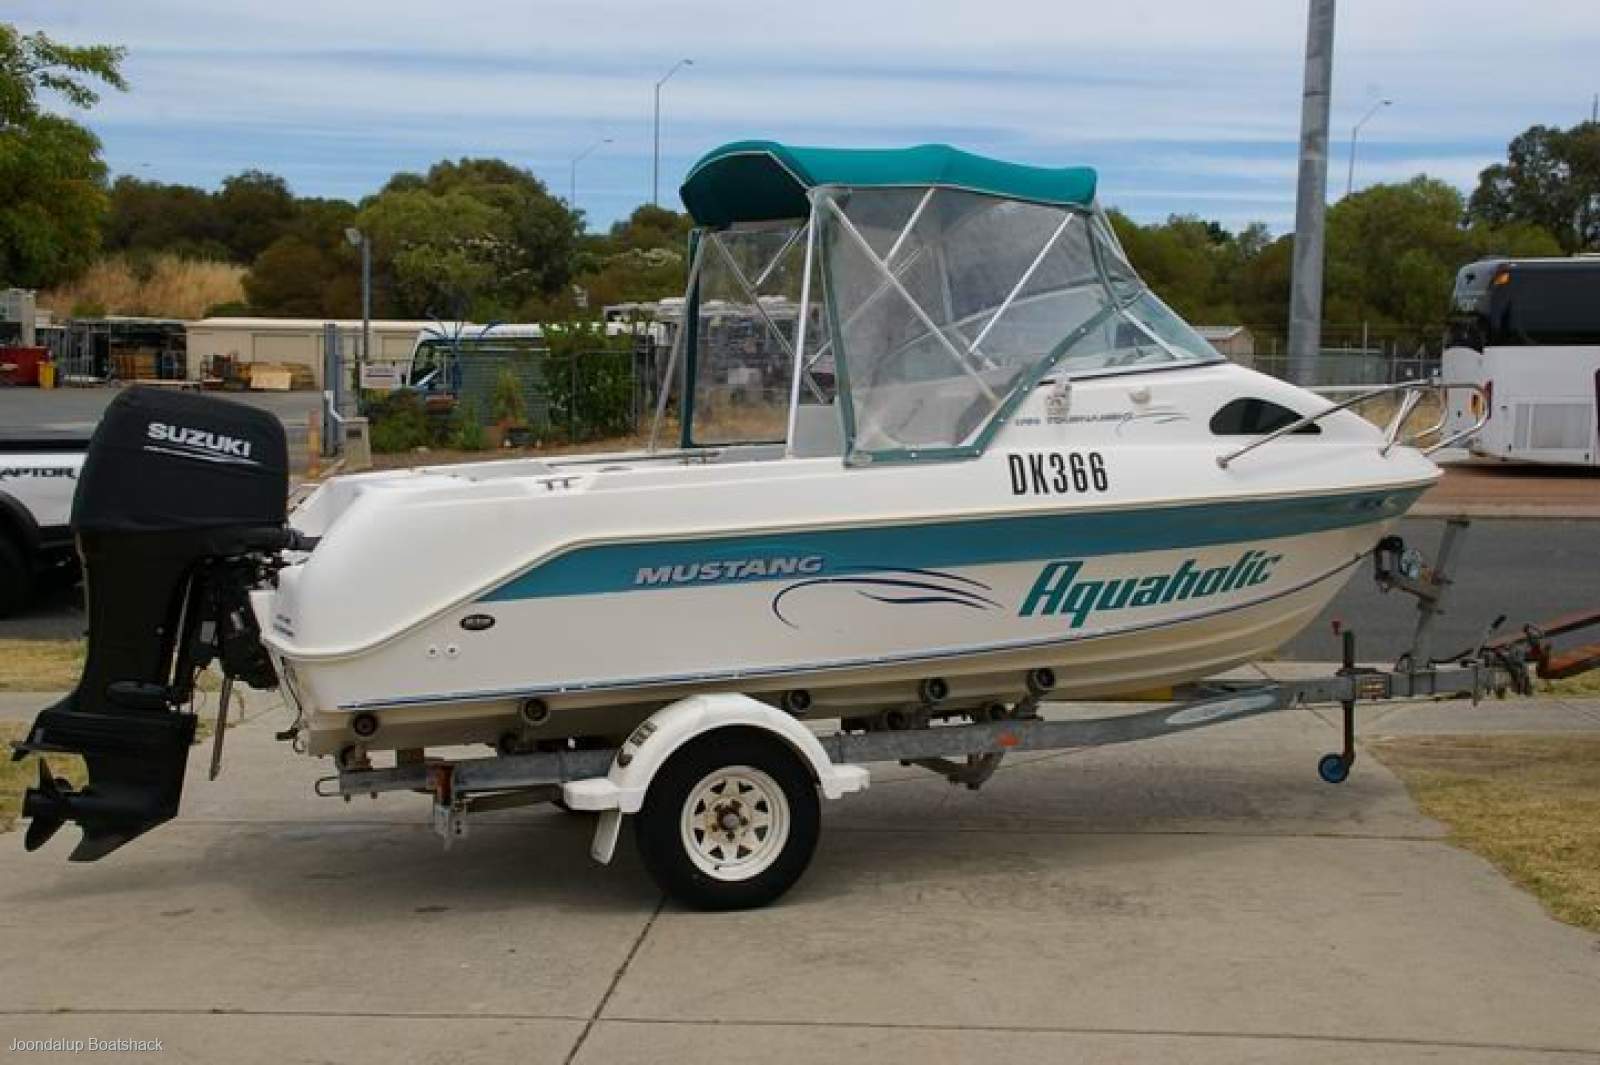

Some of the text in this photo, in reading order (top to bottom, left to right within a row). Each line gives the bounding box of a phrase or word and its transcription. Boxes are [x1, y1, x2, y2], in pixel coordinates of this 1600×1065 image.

[147, 422, 252, 458] SUZUKI
[0, 467, 79, 479] APTOR
[1008, 452, 1109, 496] DK366
[635, 556, 823, 587] MUSTANG
[1018, 550, 1283, 629] Aquaholic
